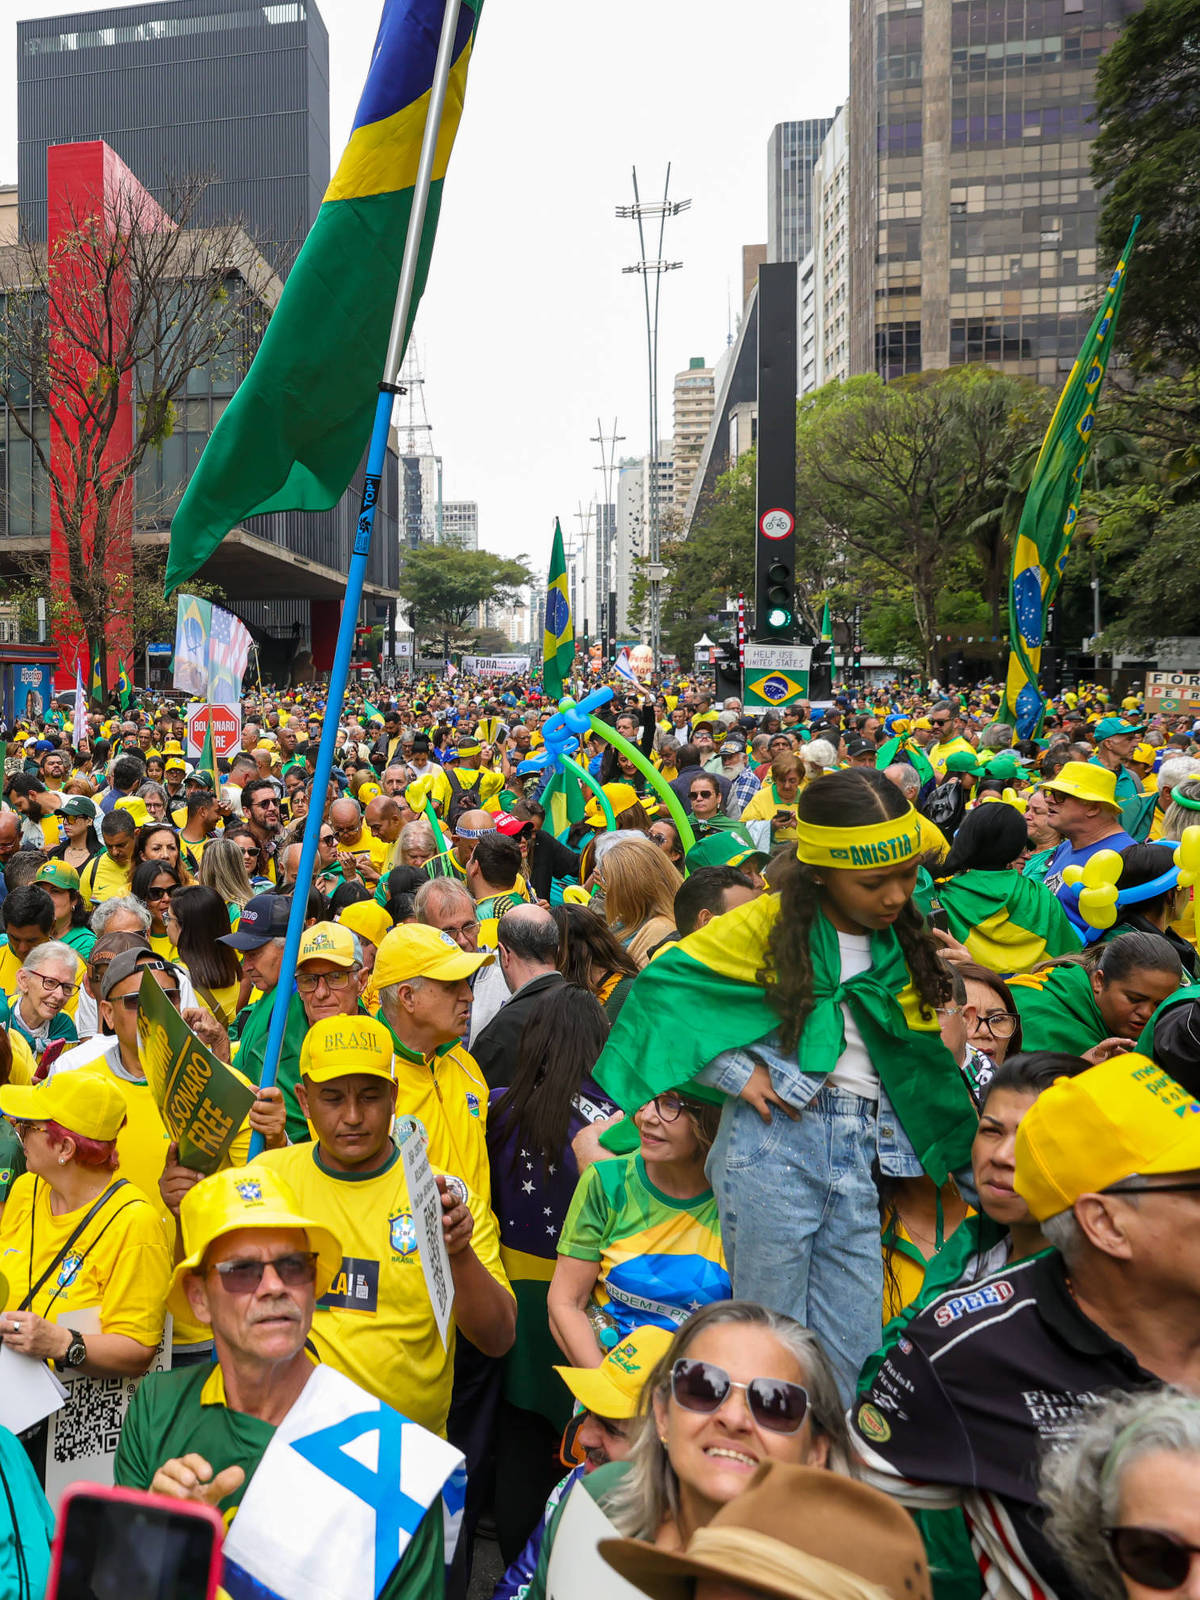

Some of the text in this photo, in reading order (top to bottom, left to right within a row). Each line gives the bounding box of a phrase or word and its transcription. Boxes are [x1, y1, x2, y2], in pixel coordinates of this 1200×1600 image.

[753, 650, 776, 658] HELP
[1153, 673, 1200, 685] FOR
[194, 721, 235, 731] BOLONARO
[850, 833, 912, 866] ANISTIA
[325, 1031, 377, 1049] BRASIL
[187, 1097, 234, 1158] FREE
[656, 1303, 667, 1313] E
[934, 1280, 1015, 1328] SPEED
[884, 1359, 915, 1393] Finish
